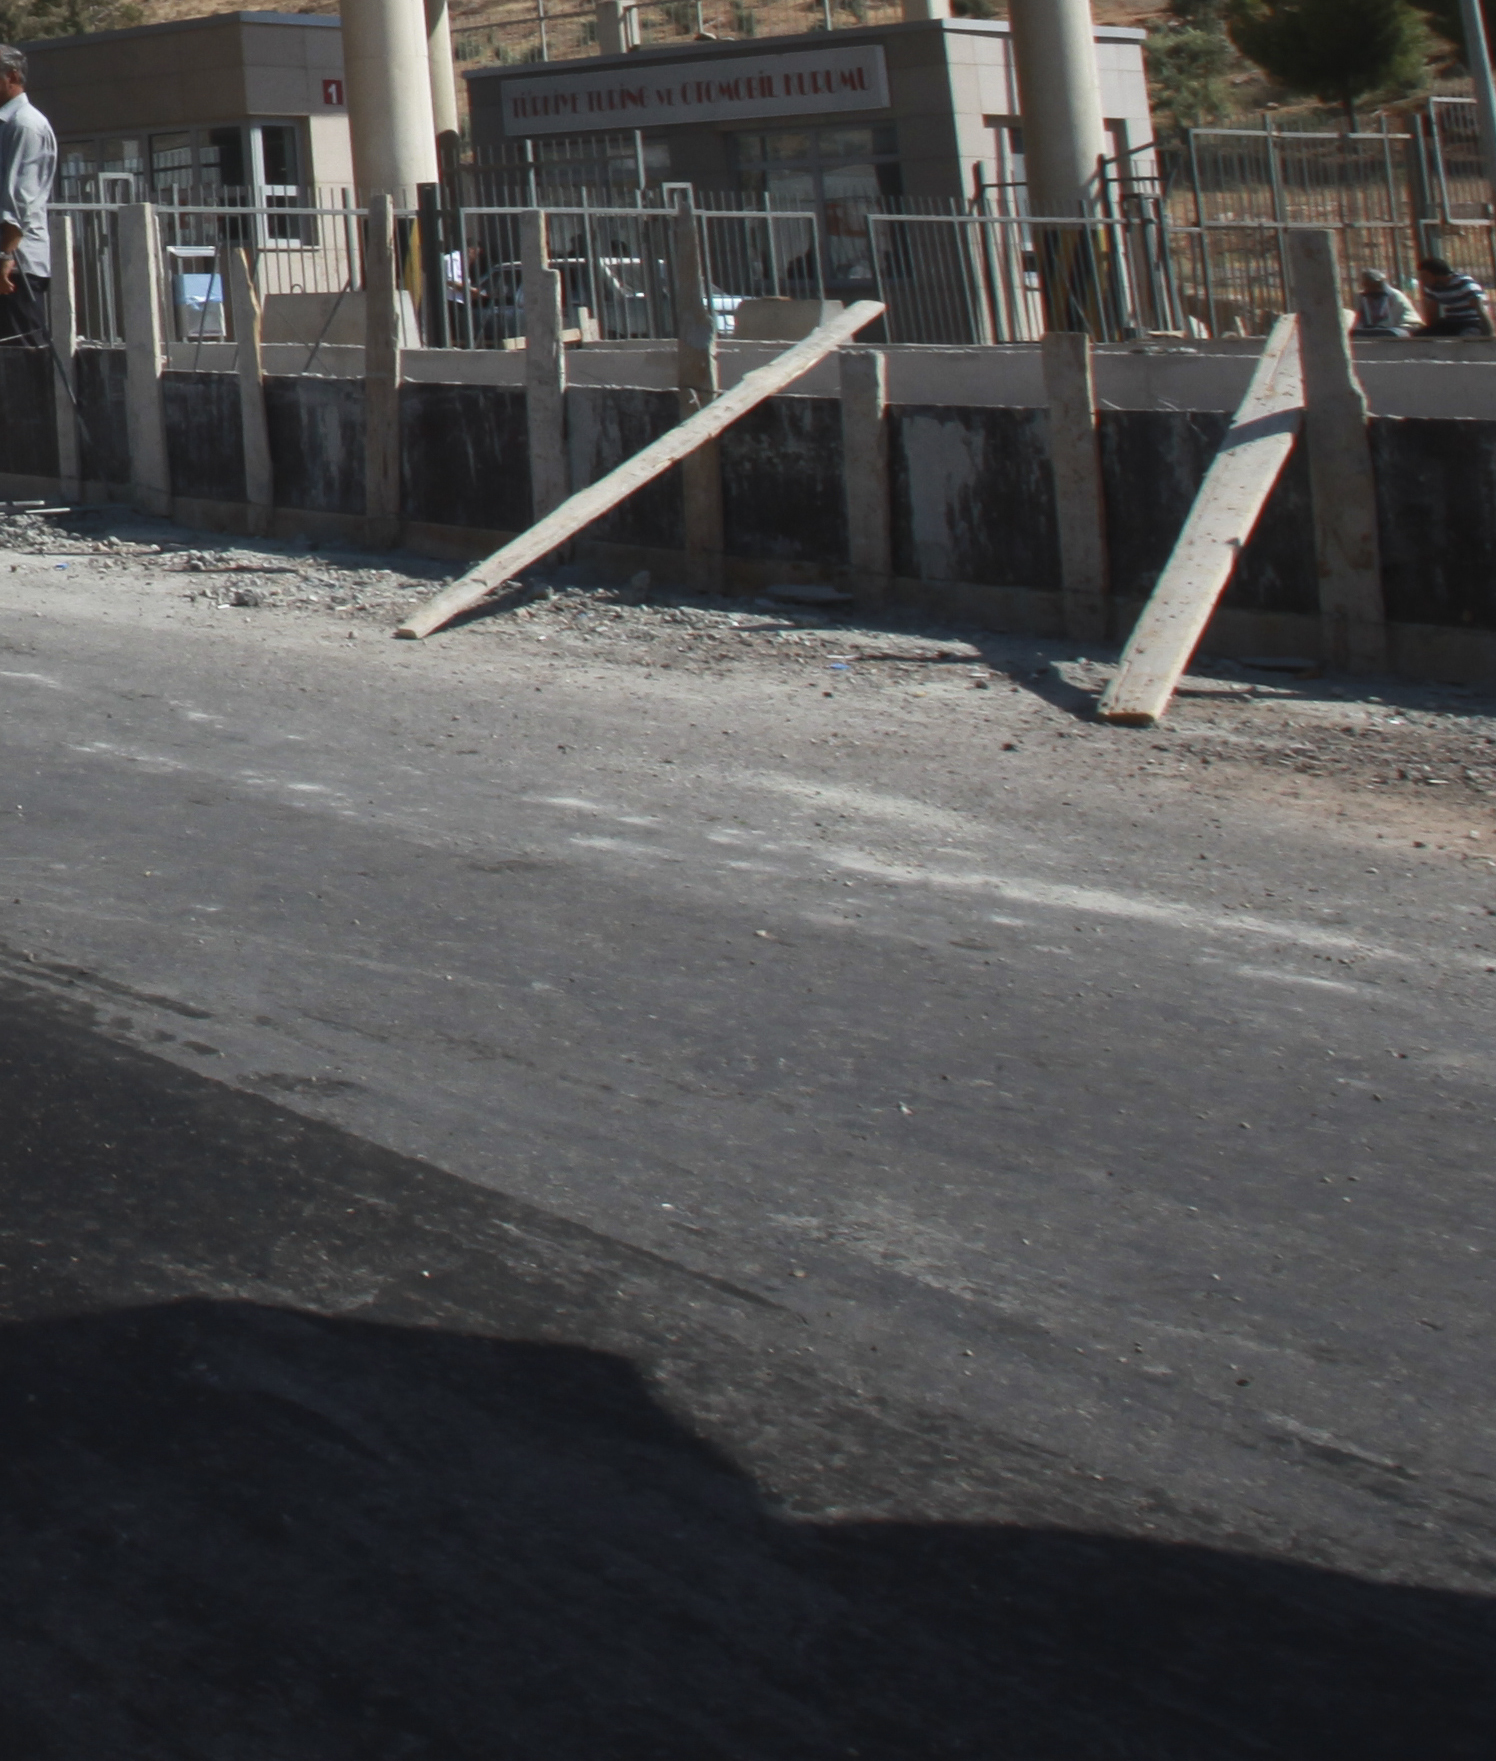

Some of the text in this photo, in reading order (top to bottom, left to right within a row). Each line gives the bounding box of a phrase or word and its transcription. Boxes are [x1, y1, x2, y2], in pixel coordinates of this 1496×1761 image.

[328, 83, 338, 104] 1
[510, 89, 578, 118] TÜRKİYE
[680, 73, 778, 105] OTOMOBİL
[783, 67, 870, 96] KURUMU
